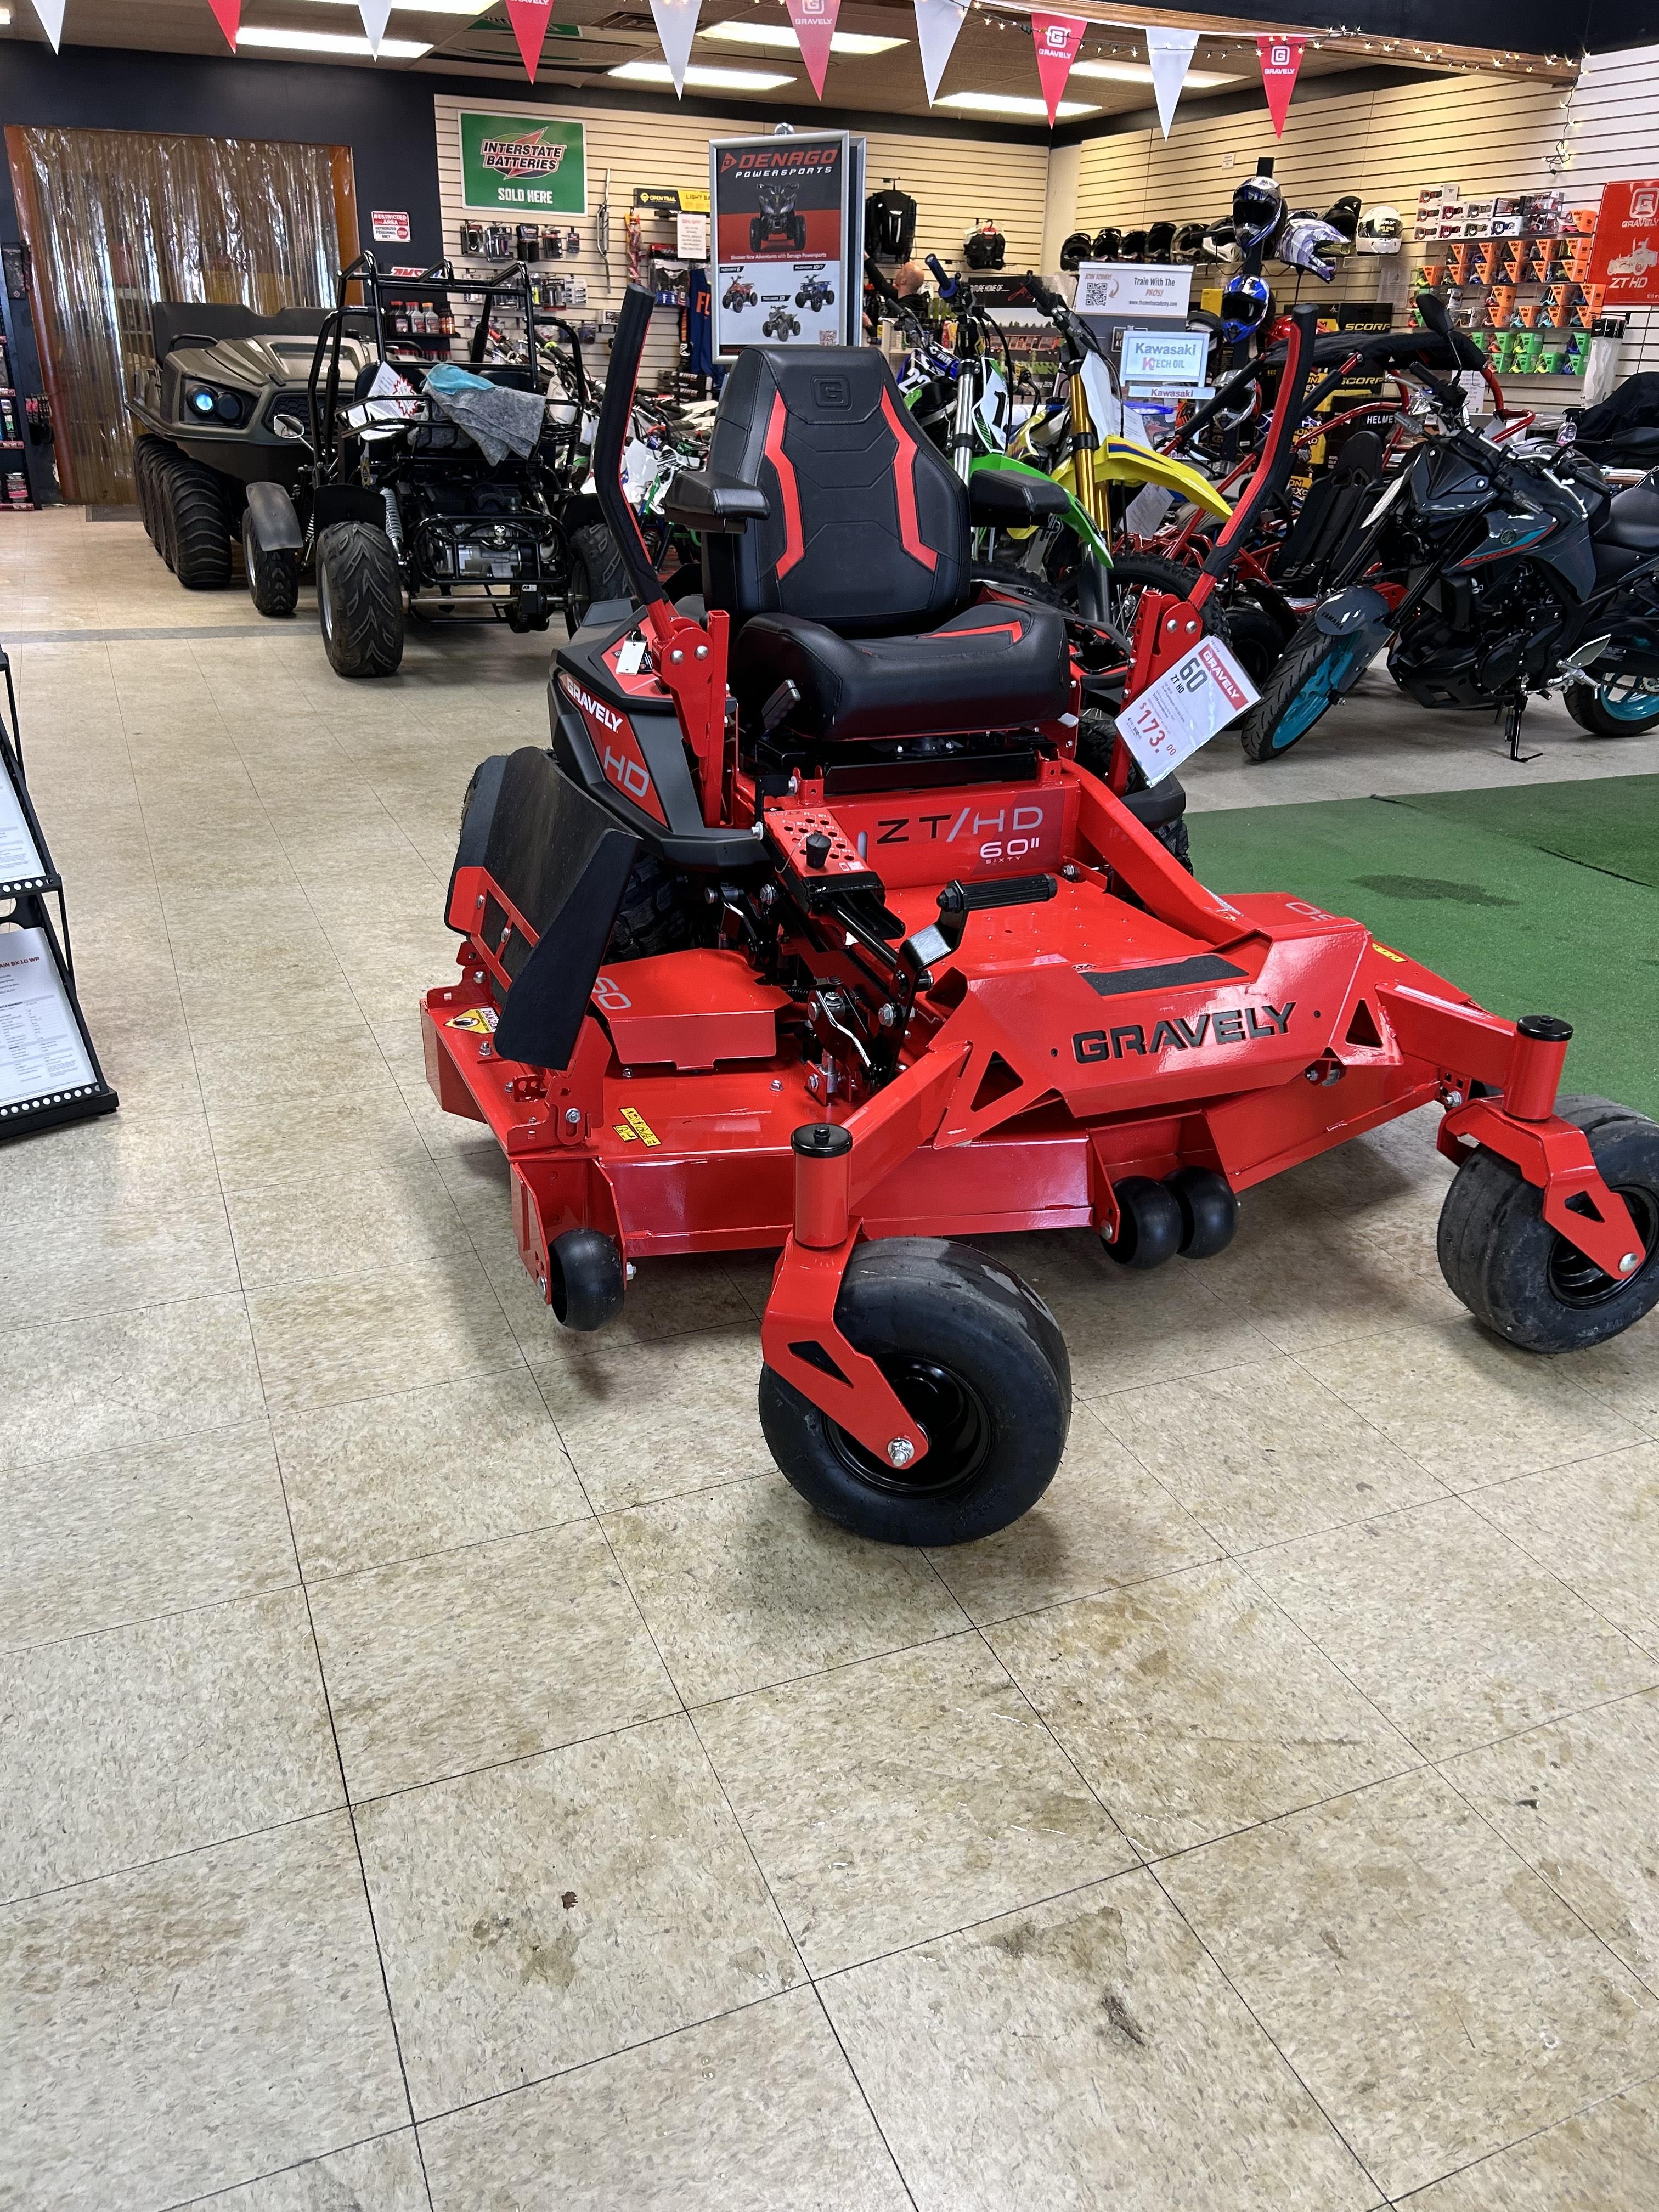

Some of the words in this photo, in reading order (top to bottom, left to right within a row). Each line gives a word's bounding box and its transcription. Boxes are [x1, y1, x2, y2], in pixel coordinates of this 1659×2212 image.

[1039, 48, 1072, 59] GRAVELY
[483, 142, 562, 158] INTERSTATE
[486, 155, 557, 170] BATTERIES
[738, 149, 839, 169] DENAGO
[735, 166, 833, 178] POWERSPORTS
[498, 187, 525, 202] SOLD
[527, 189, 554, 204] HERE
[1621, 218, 1659, 228] GRAVELY
[1134, 276, 1149, 286] Train
[1150, 278, 1164, 286] With
[1165, 278, 1175, 286] The
[1608, 277, 1630, 289] ZT
[1629, 277, 1648, 289] HD
[1145, 288, 1164, 297] PROS!
[1135, 342, 1197, 356] Kawasaki
[1173, 360, 1185, 369] OIL
[1150, 388, 1194, 398] Kawasaki
[1321, 612, 1344, 631] YAMAHA
[1179, 657, 1208, 693] 60
[1202, 649, 1240, 699] GRAVELY
[1170, 674, 1180, 685] ZT
[1176, 682, 1185, 695] HD
[567, 676, 623, 733] GRAVELY
[603, 745, 650, 797] HD
[877, 806, 1043, 844] ZT/HD
[985, 856, 1022, 865] SIXTY
[1072, 1001, 1297, 1065] GRAVELY
